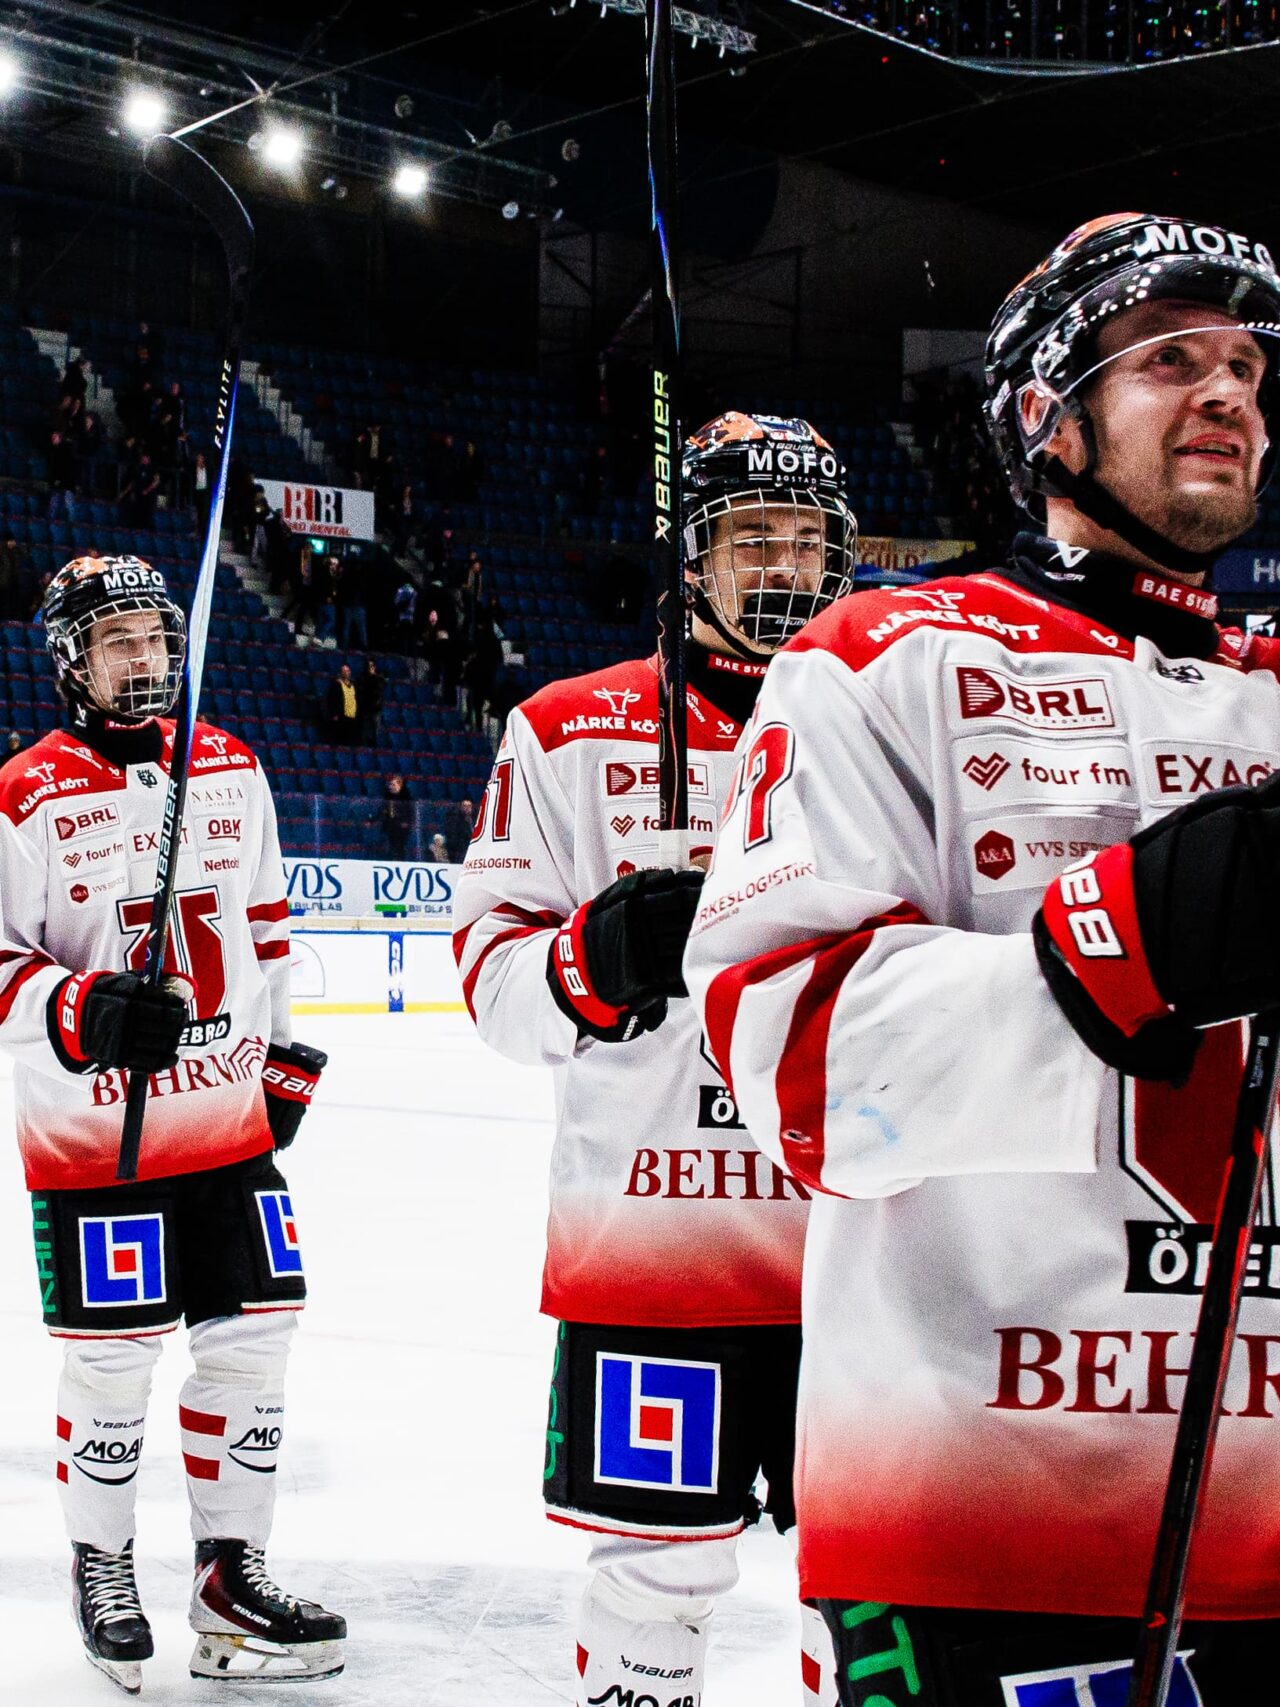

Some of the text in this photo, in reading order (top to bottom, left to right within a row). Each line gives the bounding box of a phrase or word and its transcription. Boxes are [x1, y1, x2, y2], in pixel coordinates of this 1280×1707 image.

[1143, 224, 1275, 271] MOFO
[214, 359, 232, 449] FLYLITE
[654, 370, 671, 511] BAUER
[748, 450, 837, 478] MOFO
[776, 475, 817, 484] BOSTAD
[103, 571, 164, 590] MOFO
[1141, 579, 1182, 602] BAE
[968, 613, 1040, 642] KÖTT
[715, 658, 739, 671] BAE
[1006, 682, 1105, 717] BRL
[561, 715, 626, 736] NÄRKE
[193, 755, 230, 770] NÄRKE
[1021, 757, 1130, 787] four fm
[641, 766, 704, 786] BL
[18, 777, 89, 814] NÄRKE KÖTT
[191, 787, 244, 804] NASTA
[76, 808, 117, 829] BRL
[158, 779, 178, 877] BAUER
[689, 815, 713, 832] fm
[133, 826, 189, 853] EXT
[86, 847, 111, 862] four
[977, 848, 1013, 865] A&A
[1026, 843, 1065, 860] VVS
[373, 866, 453, 903] RYDS
[232, 1603, 271, 1627] BAUER
[631, 1663, 694, 1679] BAUER
